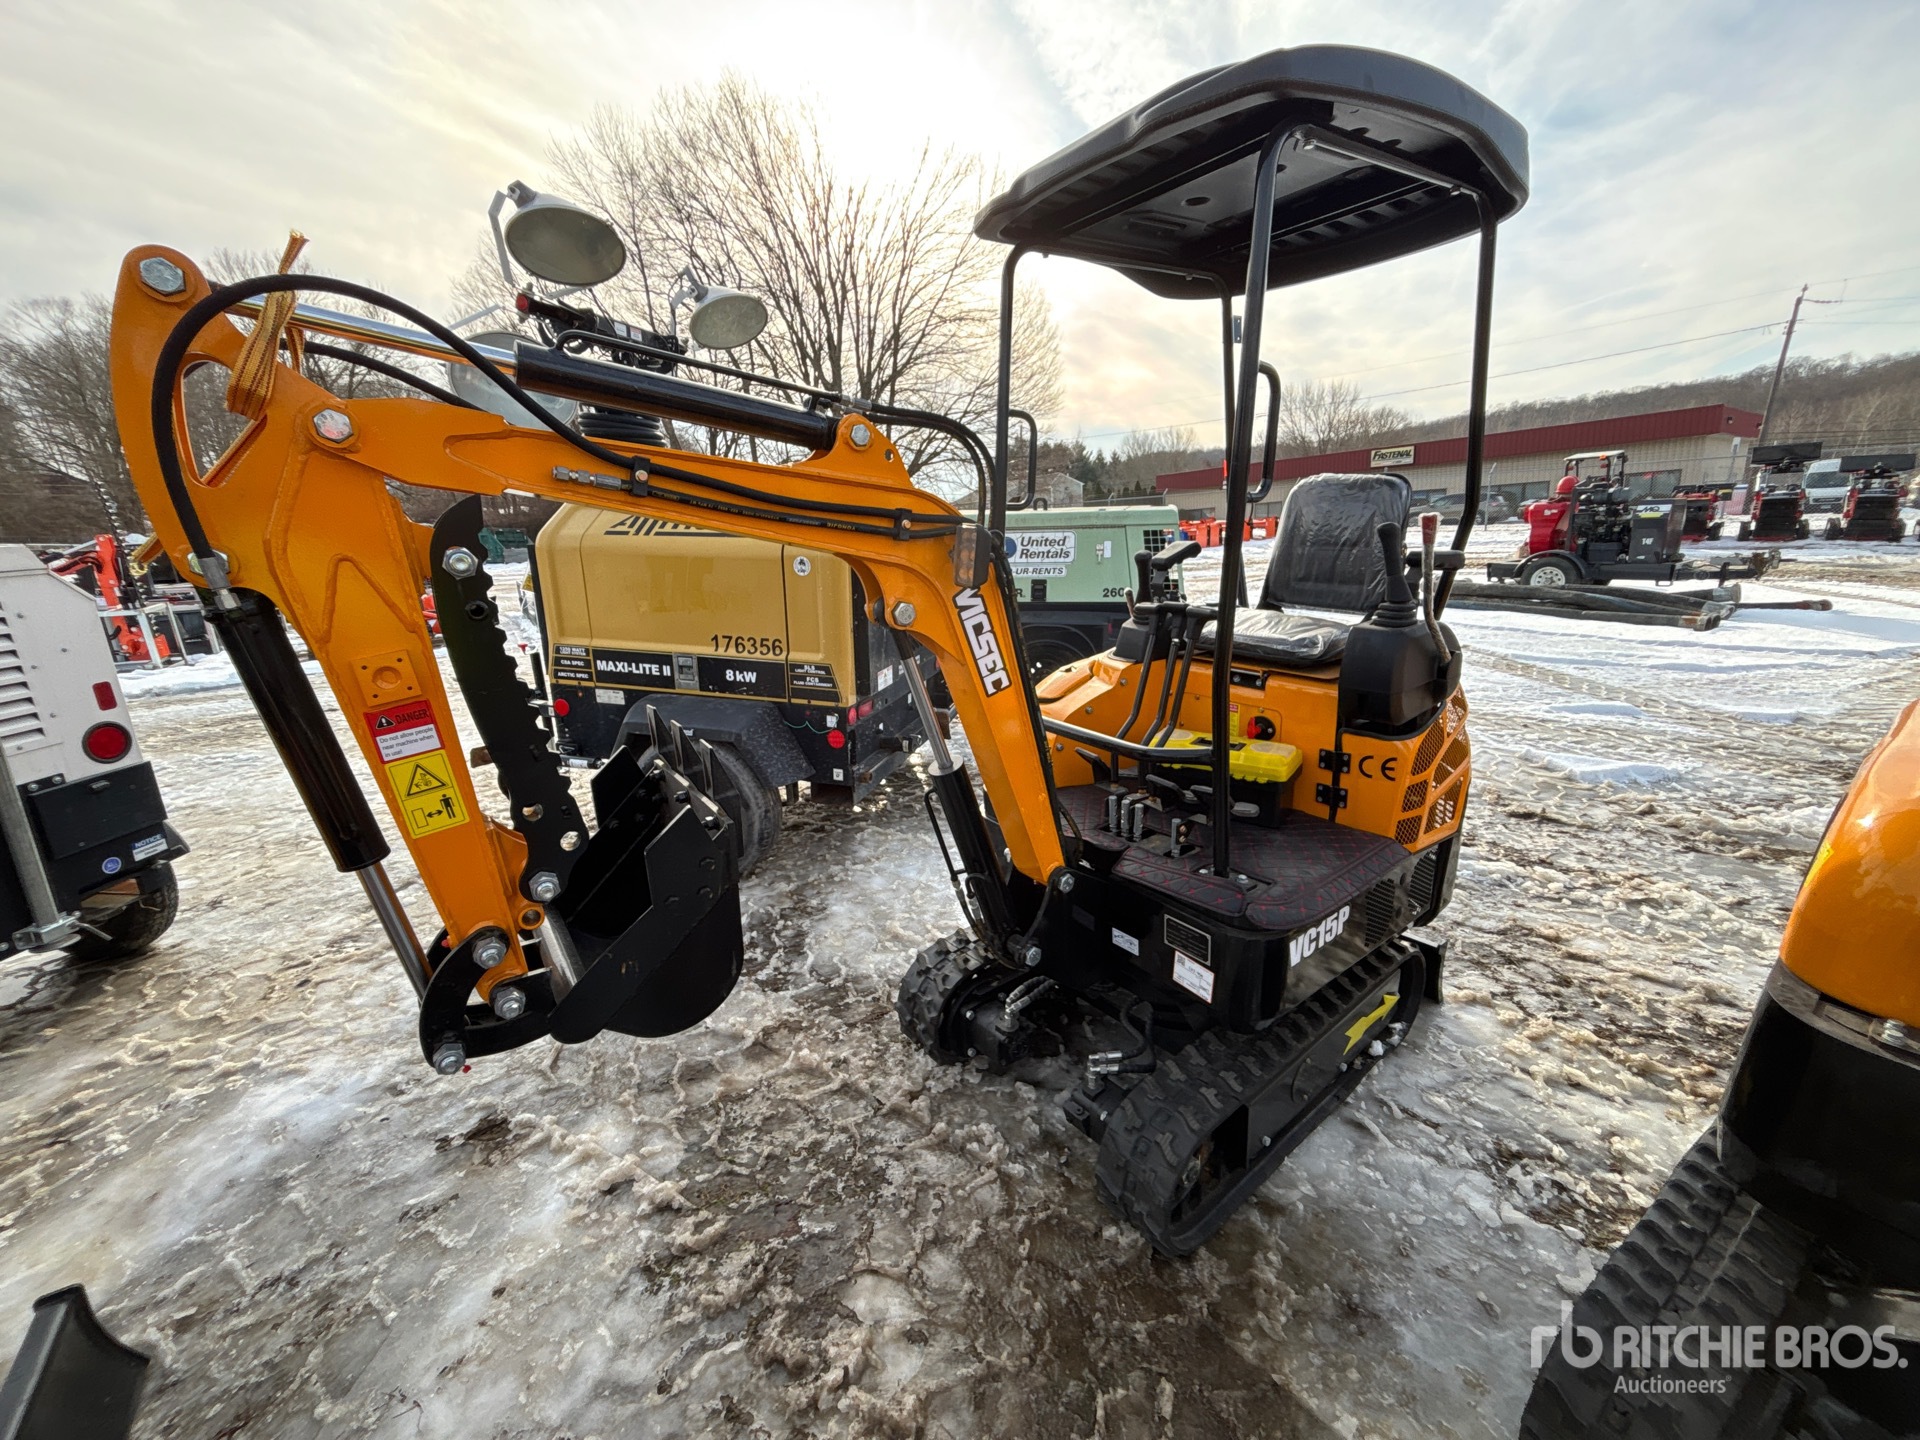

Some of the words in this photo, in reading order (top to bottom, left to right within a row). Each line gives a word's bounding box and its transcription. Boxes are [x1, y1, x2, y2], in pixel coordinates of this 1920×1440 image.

[1373, 449, 1413, 461] FASTENAL
[1020, 535, 1067, 548] United
[1019, 547, 1071, 560] Rentals
[1011, 567, 1064, 575] -UR-RENTS
[710, 634, 784, 657] 176356
[954, 586, 1011, 696] VICSEC
[596, 660, 661, 676] MAXI-LITE
[394, 708, 430, 725] DANGER
[388, 734, 400, 742] not
[399, 731, 415, 739] allow
[414, 726, 434, 737] people
[395, 738, 419, 748] machine
[418, 734, 435, 742] when
[134, 833, 163, 849] NOTICE
[1288, 905, 1350, 968] VC15P
